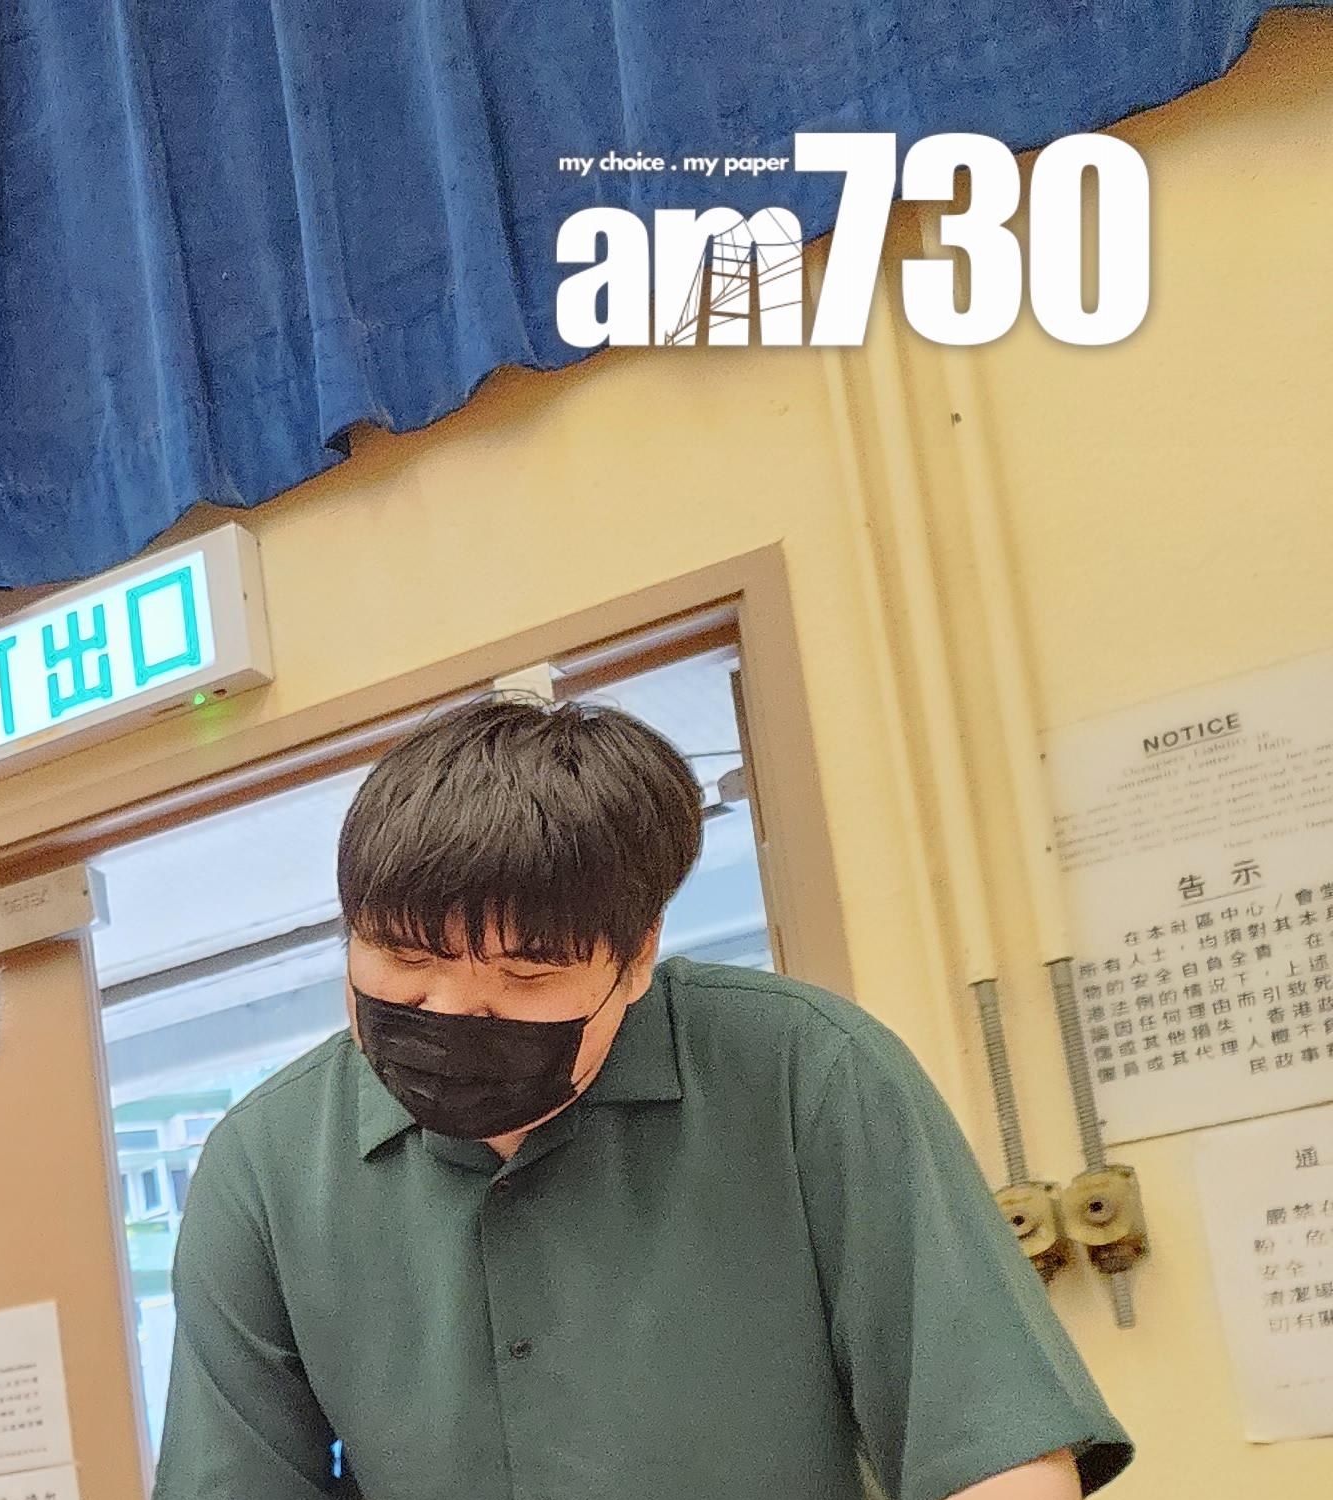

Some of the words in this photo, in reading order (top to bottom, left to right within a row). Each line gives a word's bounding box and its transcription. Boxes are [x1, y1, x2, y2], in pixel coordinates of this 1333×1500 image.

[42, 566, 202, 718] 出口
[1142, 712, 1242, 753] NOTICE
[1178, 858, 1262, 900] 告示
